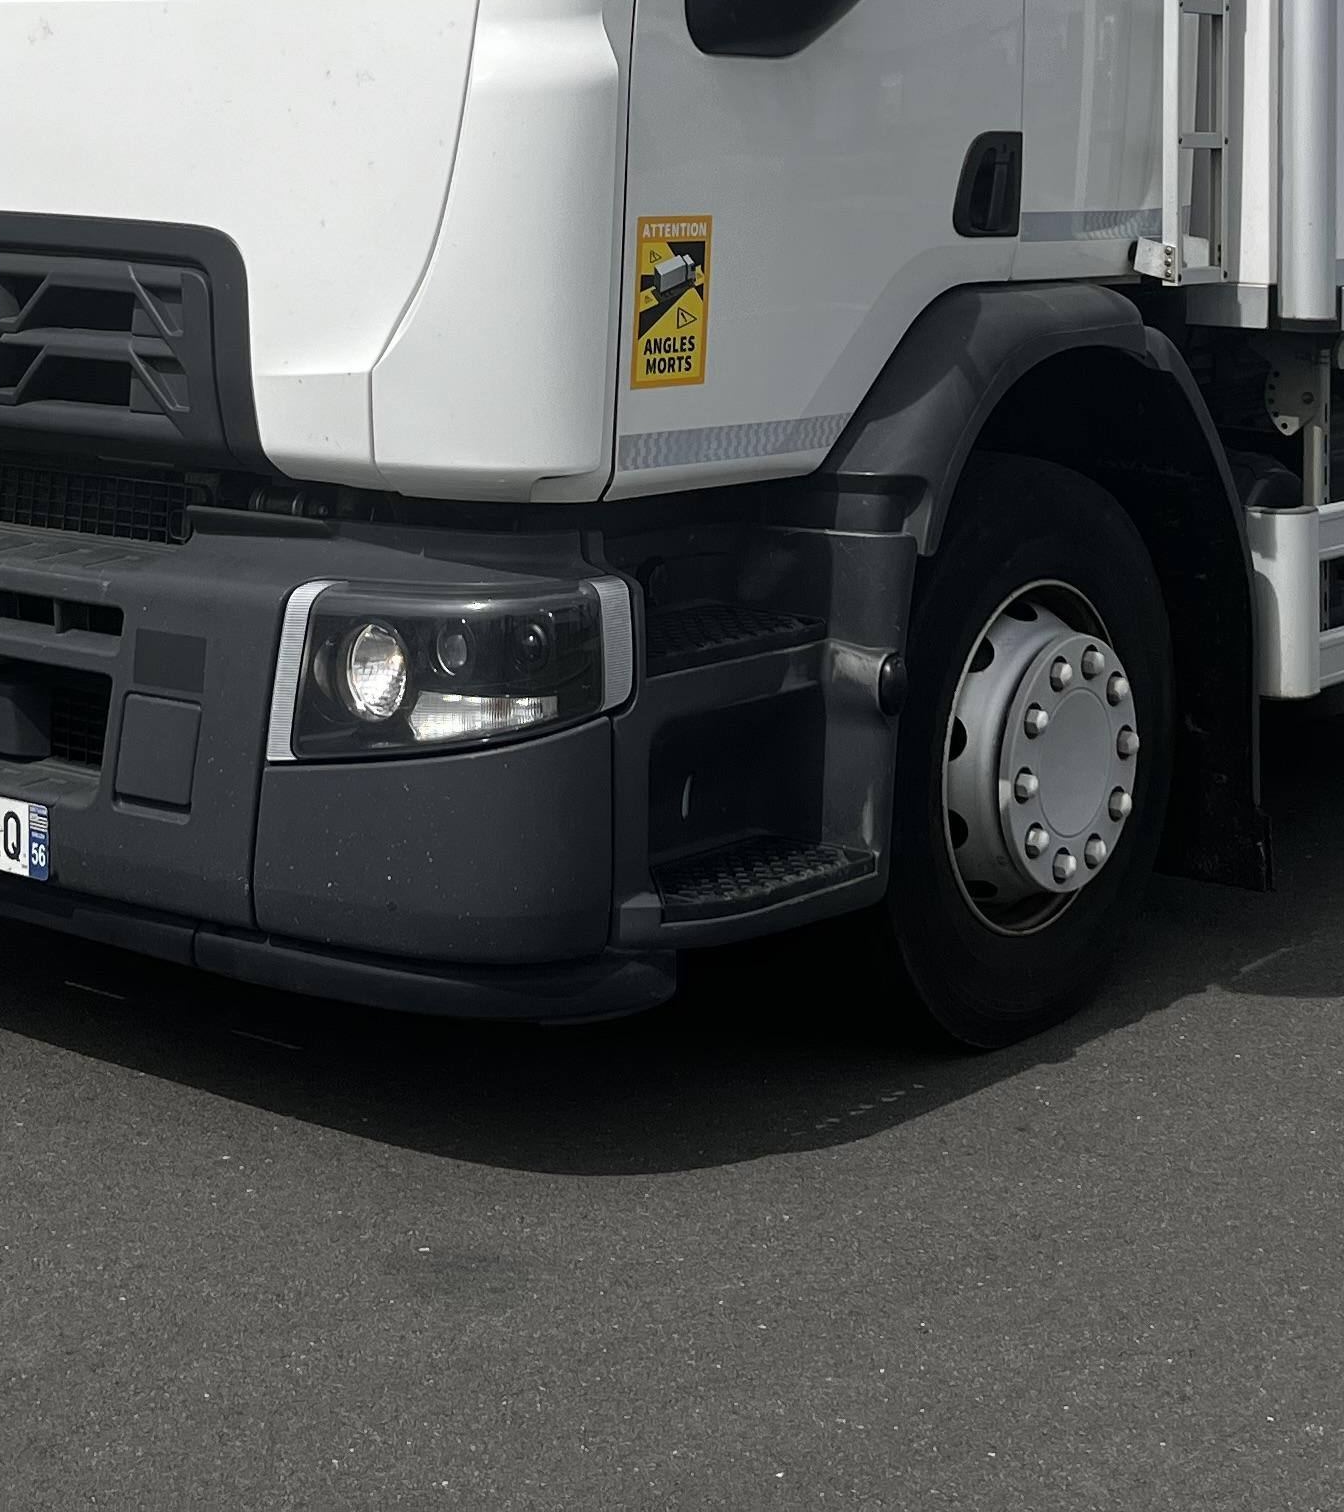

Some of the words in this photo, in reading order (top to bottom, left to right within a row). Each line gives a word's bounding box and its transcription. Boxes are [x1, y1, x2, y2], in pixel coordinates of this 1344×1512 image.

[642, 222, 707, 238] ATTENTION
[643, 335, 696, 355] ANGLES
[645, 355, 692, 375] MORTS
[31, 842, 46, 868] 56
